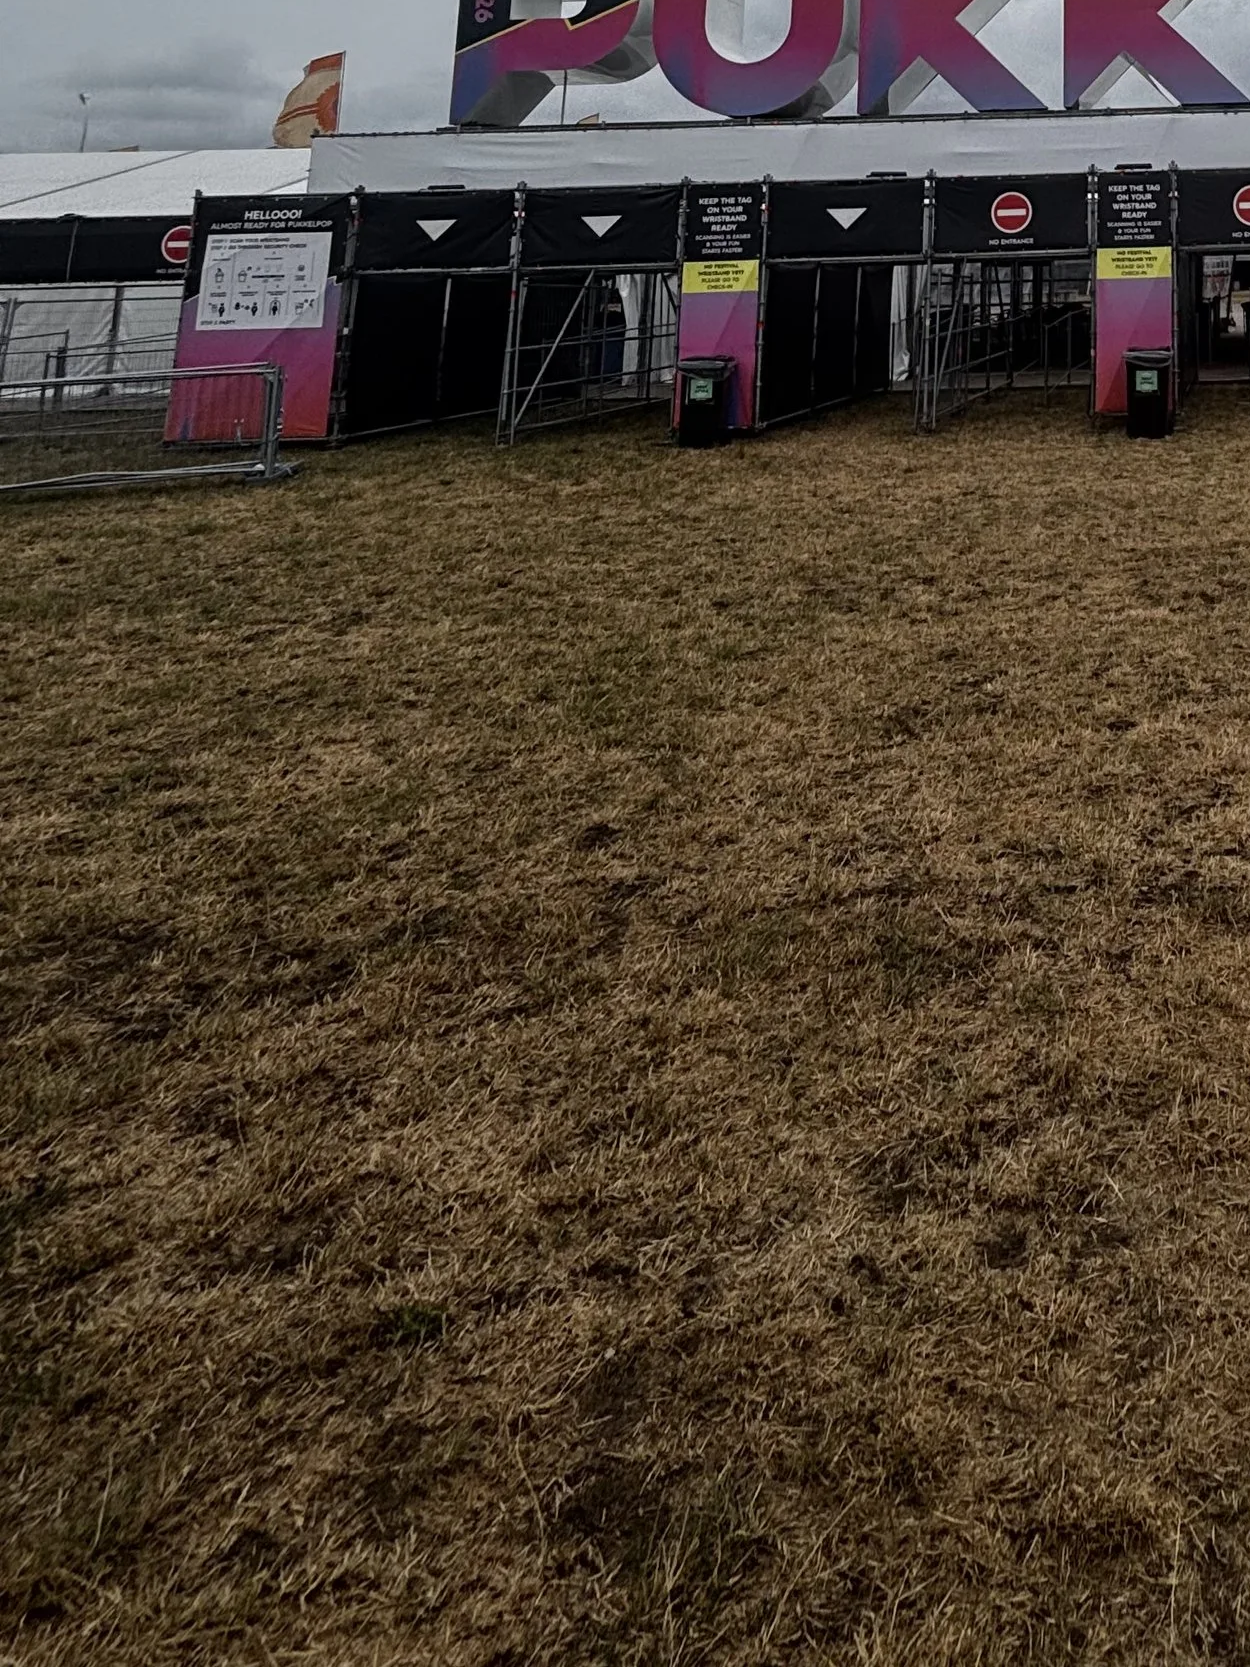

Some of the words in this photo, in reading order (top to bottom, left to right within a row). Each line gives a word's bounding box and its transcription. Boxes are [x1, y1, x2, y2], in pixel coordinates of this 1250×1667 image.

[1112, 202, 1157, 210] WRISTBAND
[244, 210, 302, 220] HELLOOO!
[287, 220, 333, 228] PUKKELPOP
